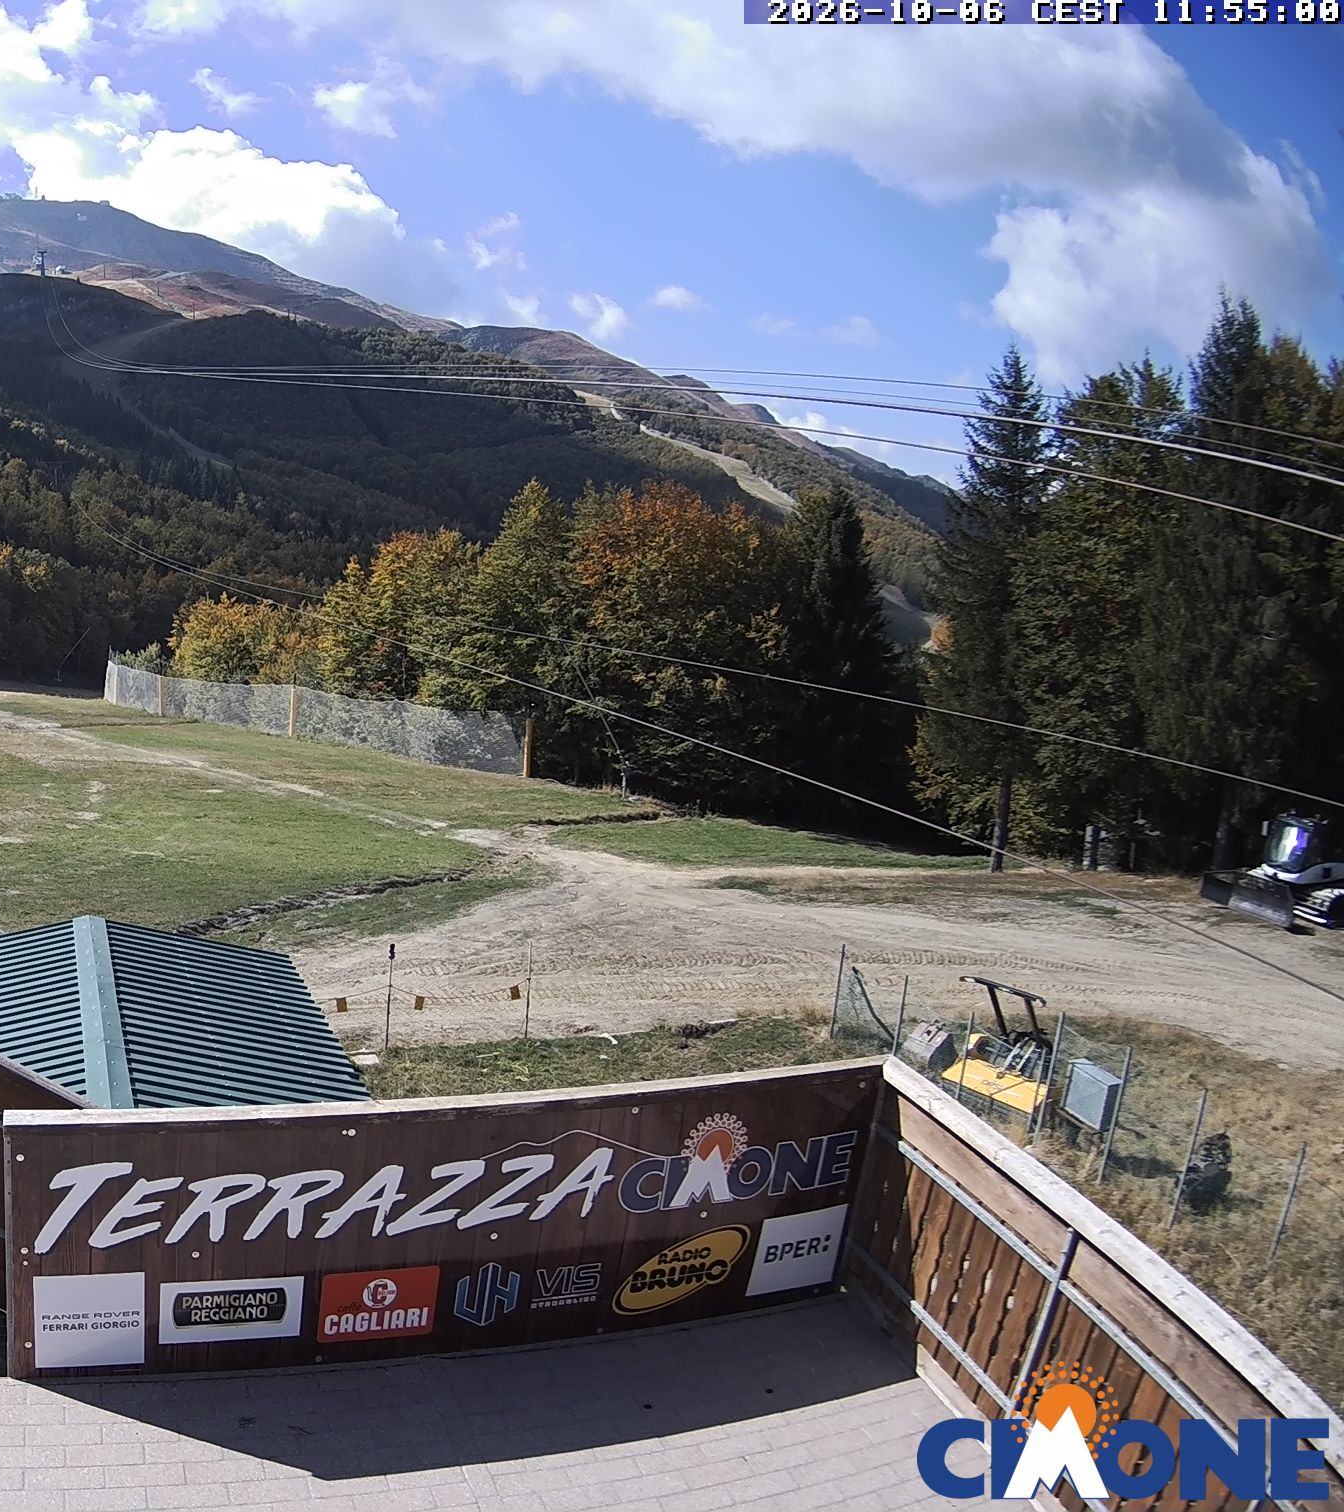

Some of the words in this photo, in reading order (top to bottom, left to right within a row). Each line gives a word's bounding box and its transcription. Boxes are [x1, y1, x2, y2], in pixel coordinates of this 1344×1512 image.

[34, 1147, 614, 1255] TERRAZZA
[618, 1129, 858, 1214] CIMONE
[657, 1246, 712, 1266] RADIO
[536, 1262, 602, 1297] VIS
[629, 1258, 730, 1294] BRUNO
[182, 1291, 278, 1310] PARMIGIANO
[41, 1313, 90, 1321] RANGE
[93, 1310, 141, 1319] ROVER
[190, 1305, 268, 1323] REGGIANO
[324, 1307, 429, 1335] CAGLIARI
[42, 1322, 88, 1332] FERRARI
[90, 1320, 140, 1330] GIORGIO
